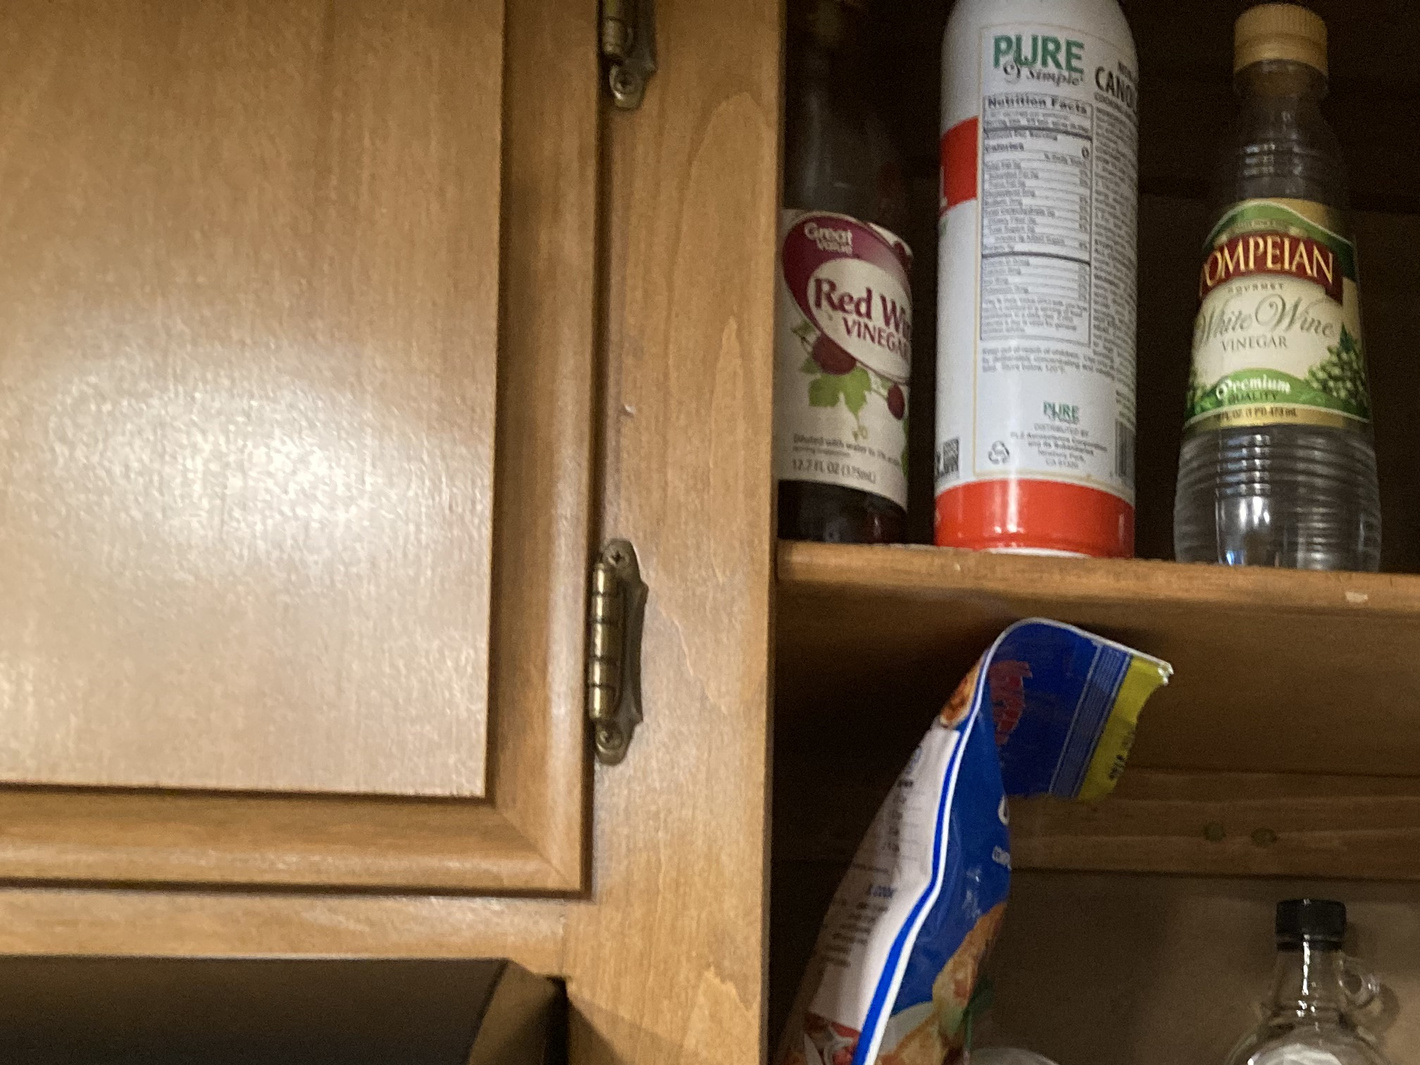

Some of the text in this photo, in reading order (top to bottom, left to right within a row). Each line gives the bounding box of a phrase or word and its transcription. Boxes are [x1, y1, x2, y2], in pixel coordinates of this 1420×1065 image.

[992, 34, 1085, 74] PURE
[988, 95, 1088, 114] Nutrition Facts
[1095, 66, 1137, 112] CANO
[804, 221, 852, 243] Great
[1203, 235, 1333, 288] OMPEIAN
[814, 278, 873, 320] Red
[1198, 293, 1335, 349] White Wine
[1220, 335, 1288, 351] VINEGAR
[1216, 374, 1291, 399] Premium
[1043, 401, 1080, 423] PURE
